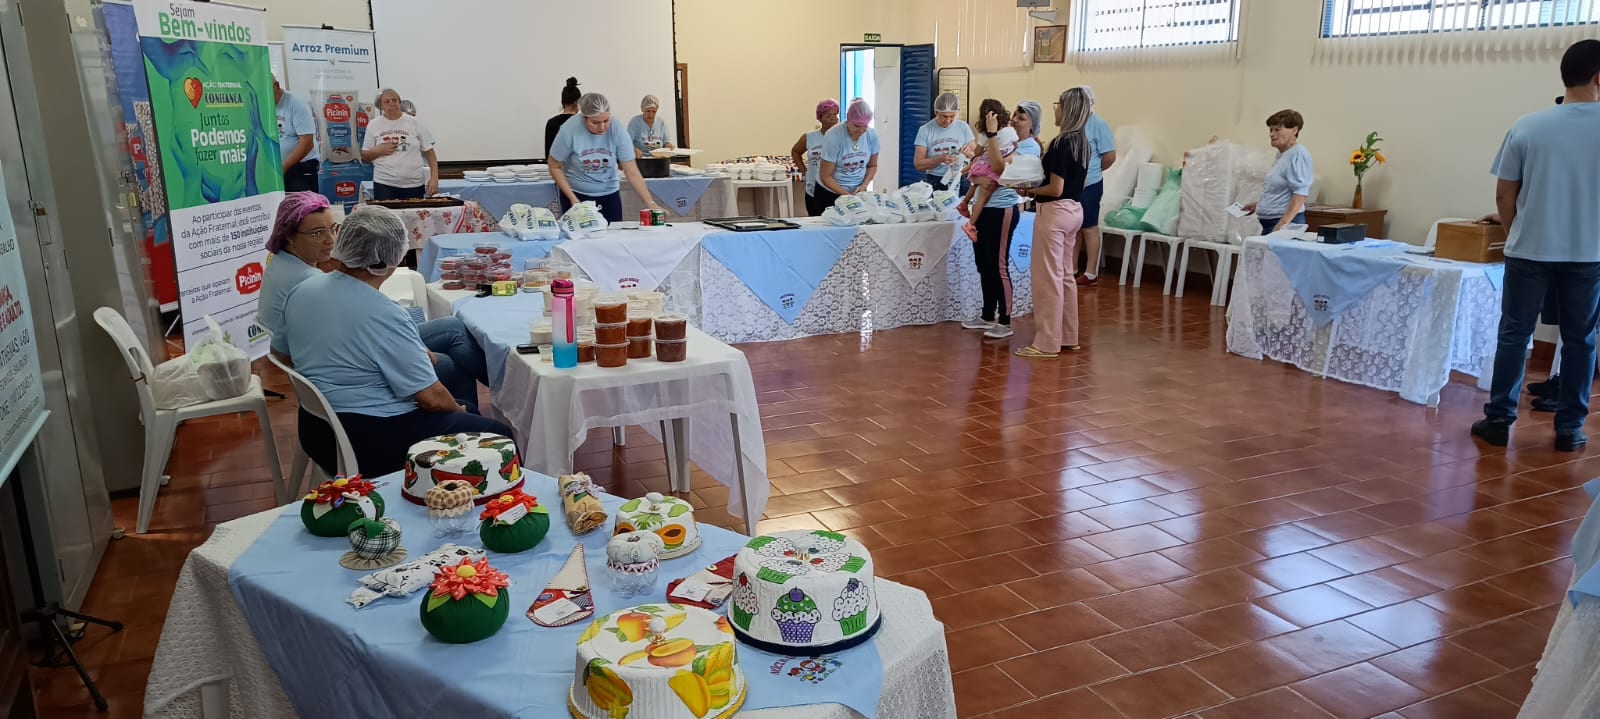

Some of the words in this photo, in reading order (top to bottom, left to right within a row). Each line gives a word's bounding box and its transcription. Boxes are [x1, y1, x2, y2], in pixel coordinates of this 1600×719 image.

[169, 3, 195, 18] Sejam
[158, 12, 251, 43] Bem-vindos
[292, 43, 322, 53] Arroz
[324, 44, 369, 56] Premium
[205, 92, 243, 105] CONFIANÇA
[200, 112, 230, 130] Juntos
[190, 127, 247, 148] Podemos
[195, 147, 217, 167] fazer
[219, 145, 247, 165] mais
[192, 215, 201, 224] Ao
[202, 210, 232, 224] participar
[181, 229, 190, 238] da
[192, 225, 207, 238] Ação
[189, 241, 203, 250] com
[204, 235, 221, 246] mais
[222, 233, 230, 242] de
[230, 230, 240, 240] 150
[200, 246, 222, 259] sociais
[223, 244, 231, 254] da
[239, 272, 262, 287] Picinin
